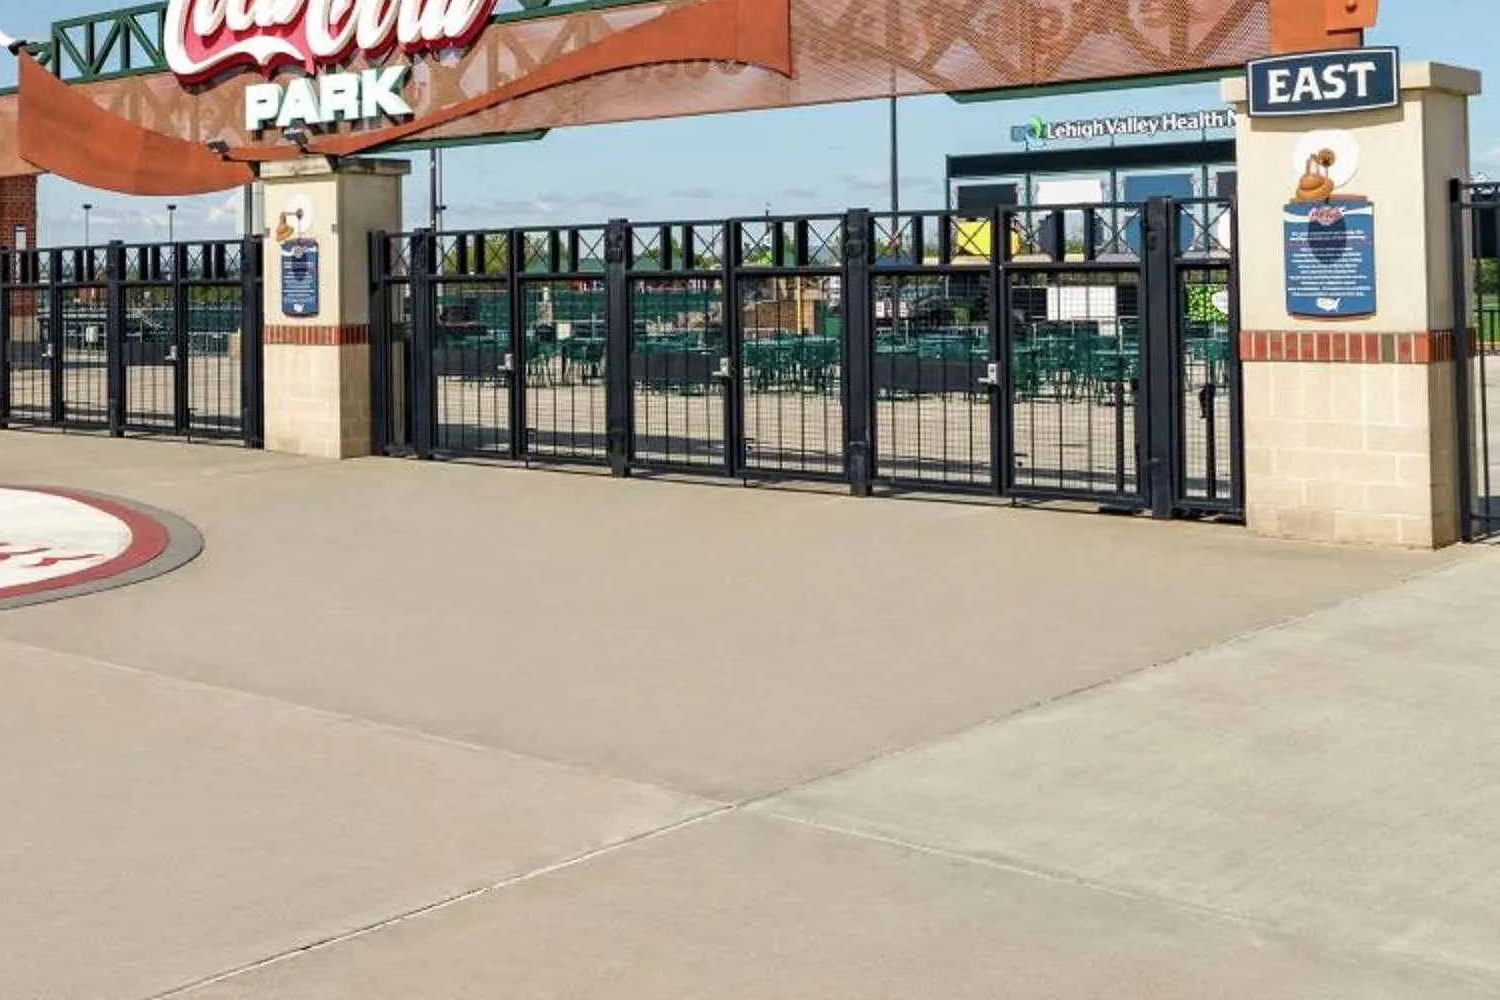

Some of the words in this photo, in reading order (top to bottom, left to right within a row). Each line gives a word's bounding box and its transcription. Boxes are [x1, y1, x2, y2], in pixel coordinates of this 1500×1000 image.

[244, 64, 410, 131] PARK
[1267, 60, 1377, 105] EAST
[1046, 117, 1104, 140] Lehigh
[1105, 115, 1159, 136] Valley
[1162, 110, 1224, 131] Health
